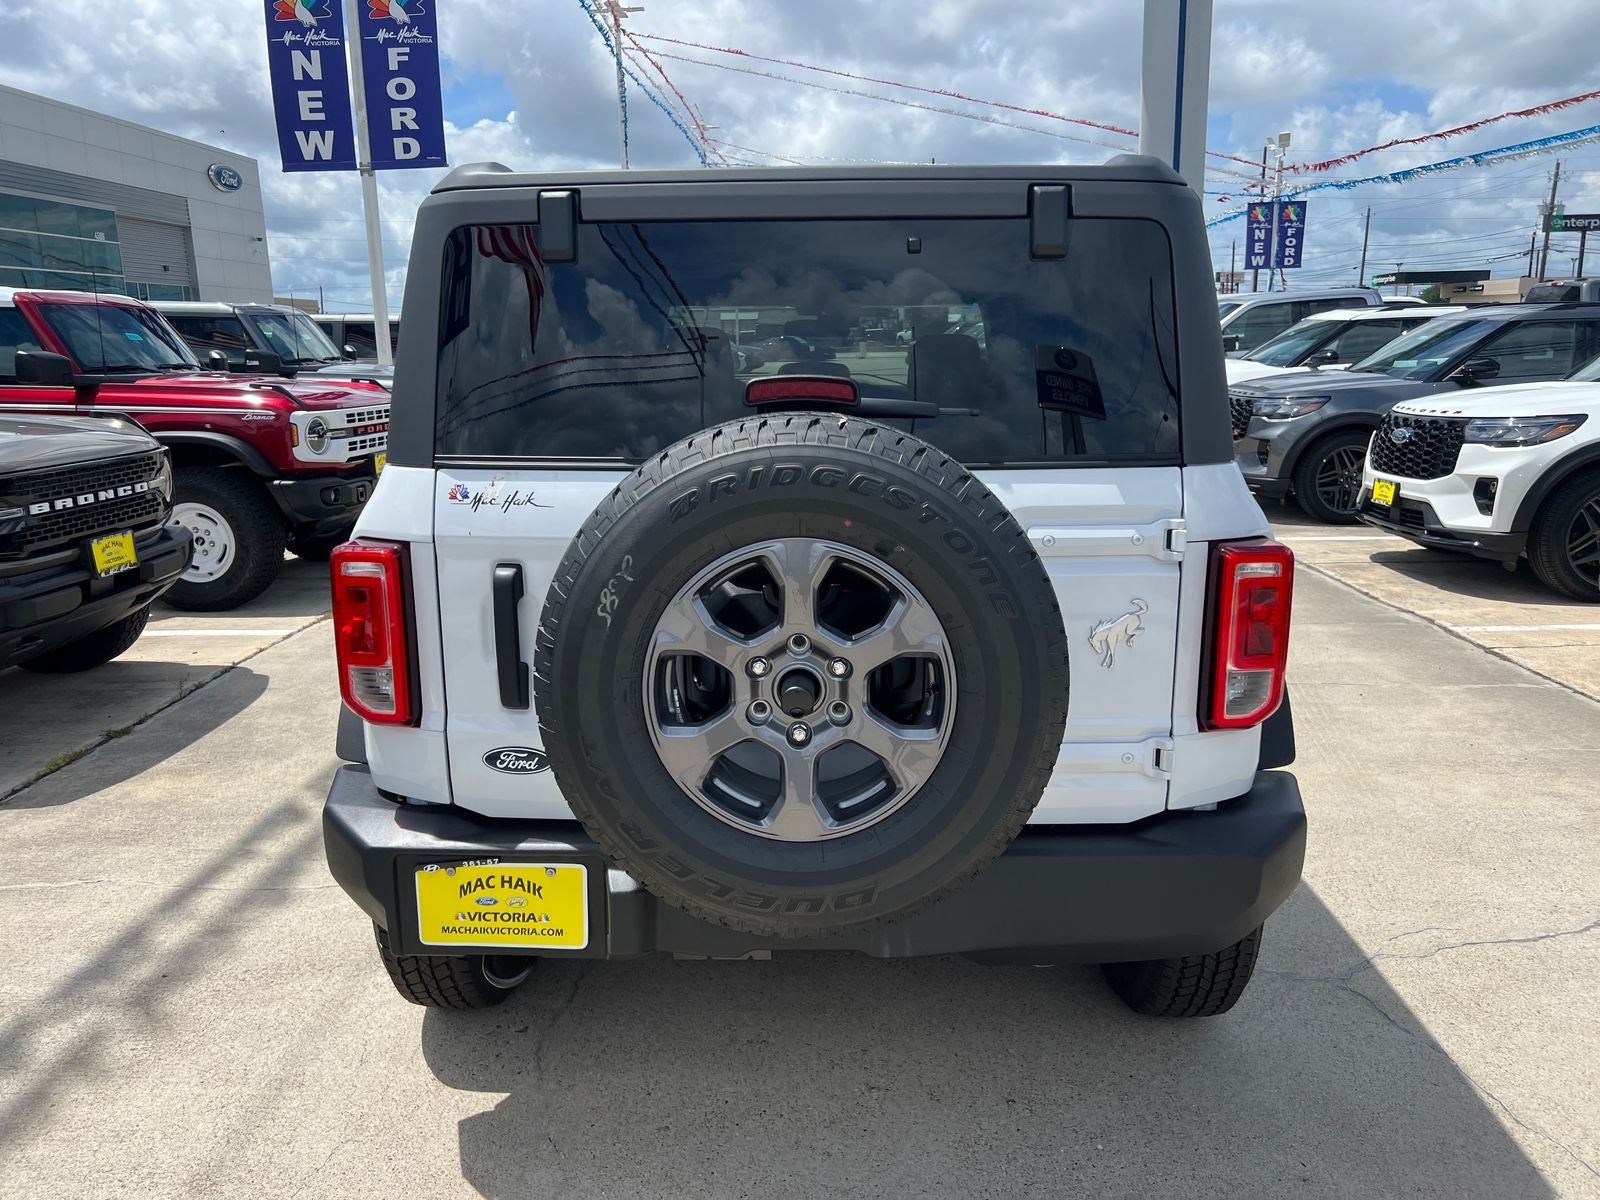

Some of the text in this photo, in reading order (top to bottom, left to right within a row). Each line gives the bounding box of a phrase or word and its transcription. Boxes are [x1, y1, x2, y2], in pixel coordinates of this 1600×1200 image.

[272, 29, 340, 46] Mac Haik
[364, 26, 433, 43] Mac Haik
[291, 50, 334, 161] NEW
[386, 47, 421, 160] FORD
[220, 169, 238, 187] Ford
[1250, 229, 1266, 267] NEW
[1283, 228, 1297, 266] FORD
[241, 412, 277, 421] Bronco
[29, 482, 149, 515] BRONCO
[501, 490, 555, 513] Haik
[668, 464, 1019, 620] BRIDGESTONE
[496, 751, 539, 769] Ford
[617, 817, 878, 915] DUELER
[459, 875, 544, 900] MAC HAIK
[467, 911, 537, 923] VICTORIA
[441, 925, 564, 937] MACHAIKVICTORIA.COM
